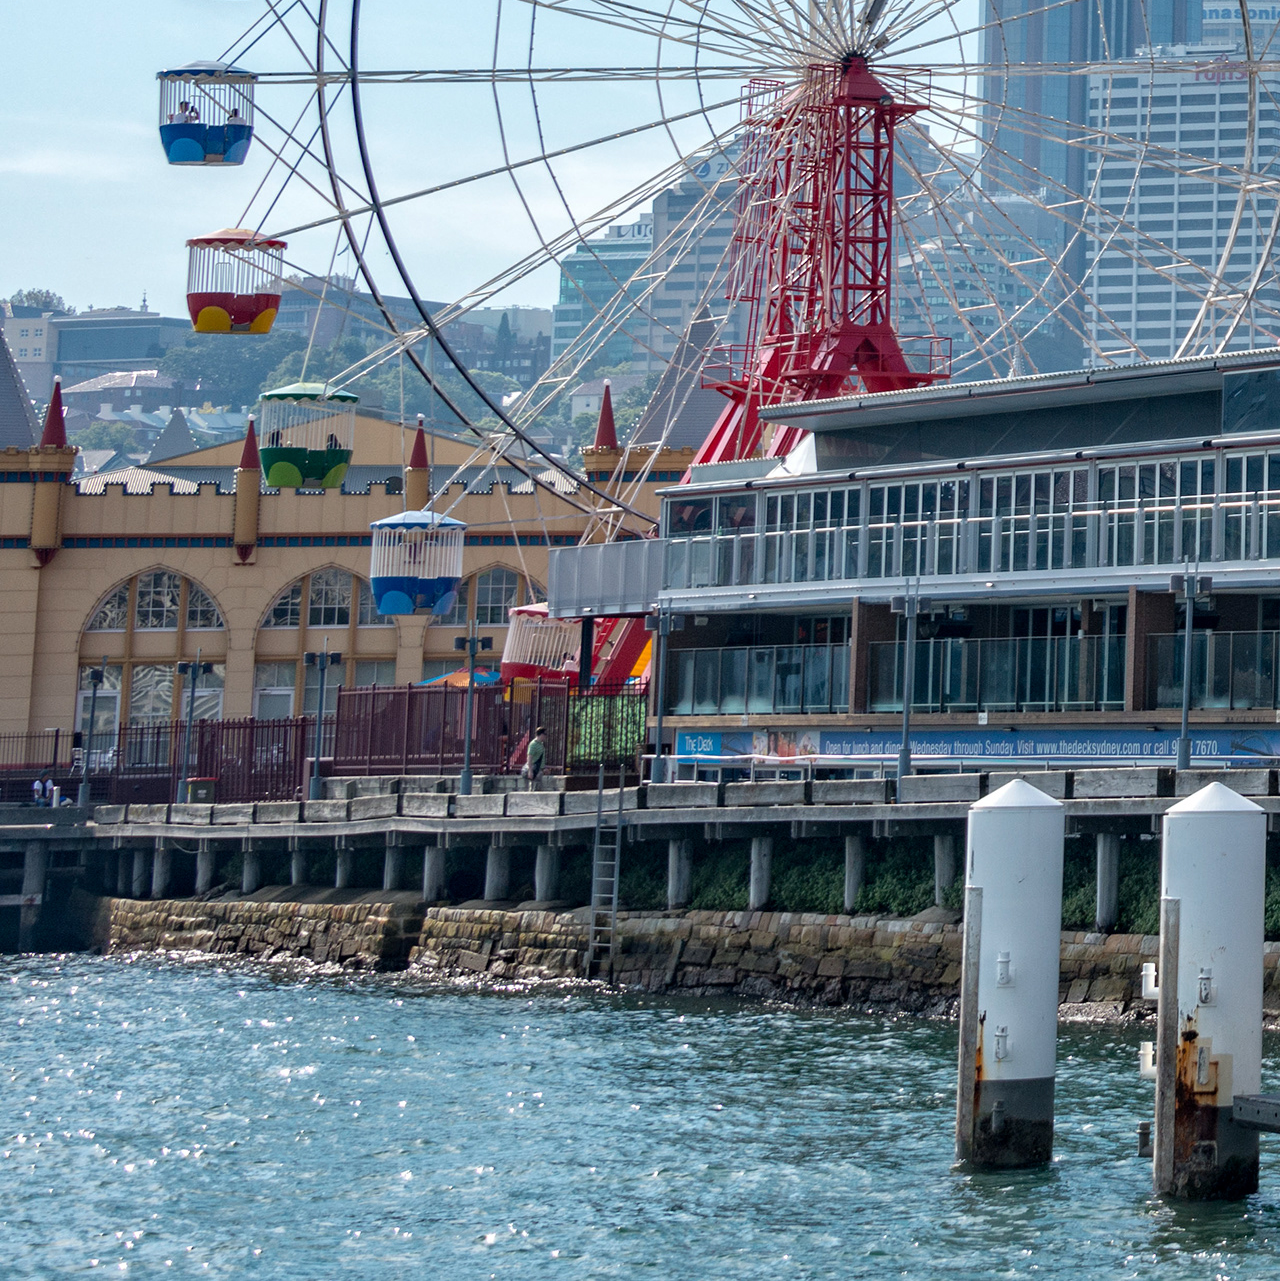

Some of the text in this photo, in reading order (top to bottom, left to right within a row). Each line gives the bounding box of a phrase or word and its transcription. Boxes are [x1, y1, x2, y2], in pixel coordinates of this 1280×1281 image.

[685, 736, 714, 752] The Deck
[825, 740, 840, 756] Open
[842, 740, 851, 754] for
[852, 740, 870, 754] lunch
[870, 741, 884, 754] and
[910, 740, 951, 756] Wednesday
[954, 740, 983, 756] through
[985, 739, 1015, 756] Sunday.
[1017, 739, 1034, 754] Visit
[1036, 739, 1141, 756] www.thedecksydney.com
[1143, 742, 1152, 755] or
[1154, 739, 1169, 755] call
[1195, 740, 1220, 755] 7670.
